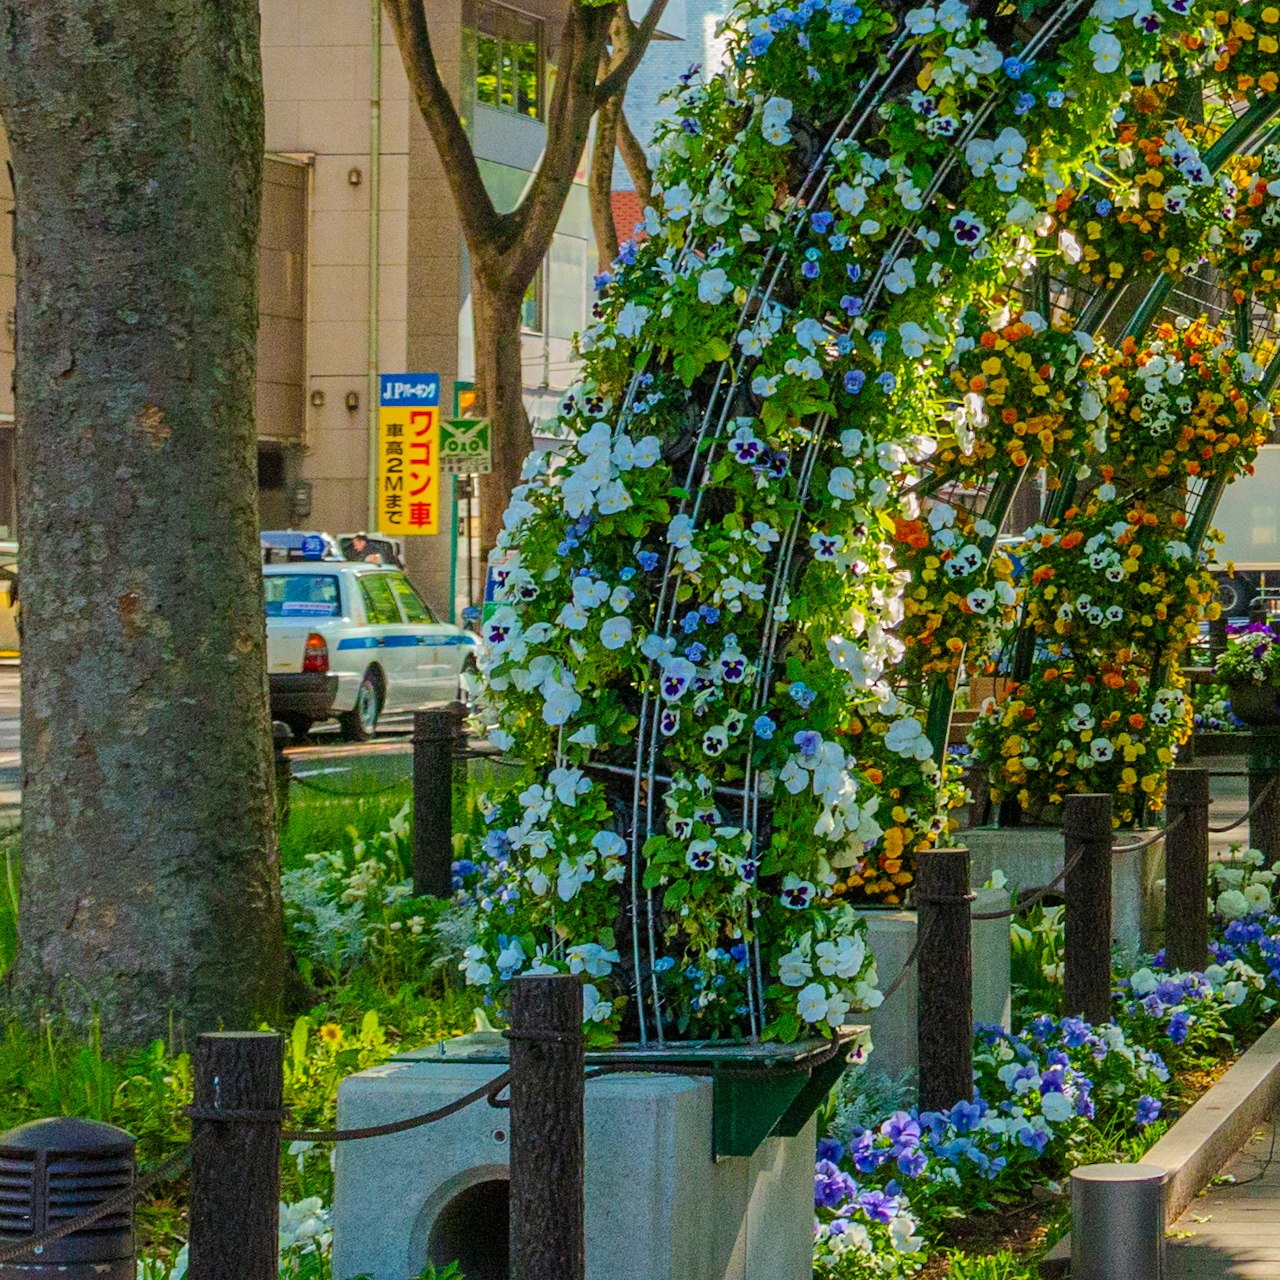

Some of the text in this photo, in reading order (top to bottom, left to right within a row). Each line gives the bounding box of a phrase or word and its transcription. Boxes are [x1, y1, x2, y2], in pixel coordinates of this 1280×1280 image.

[385, 423, 404, 525] 車高2Mまで
[408, 410, 433, 528] ワゴン車
